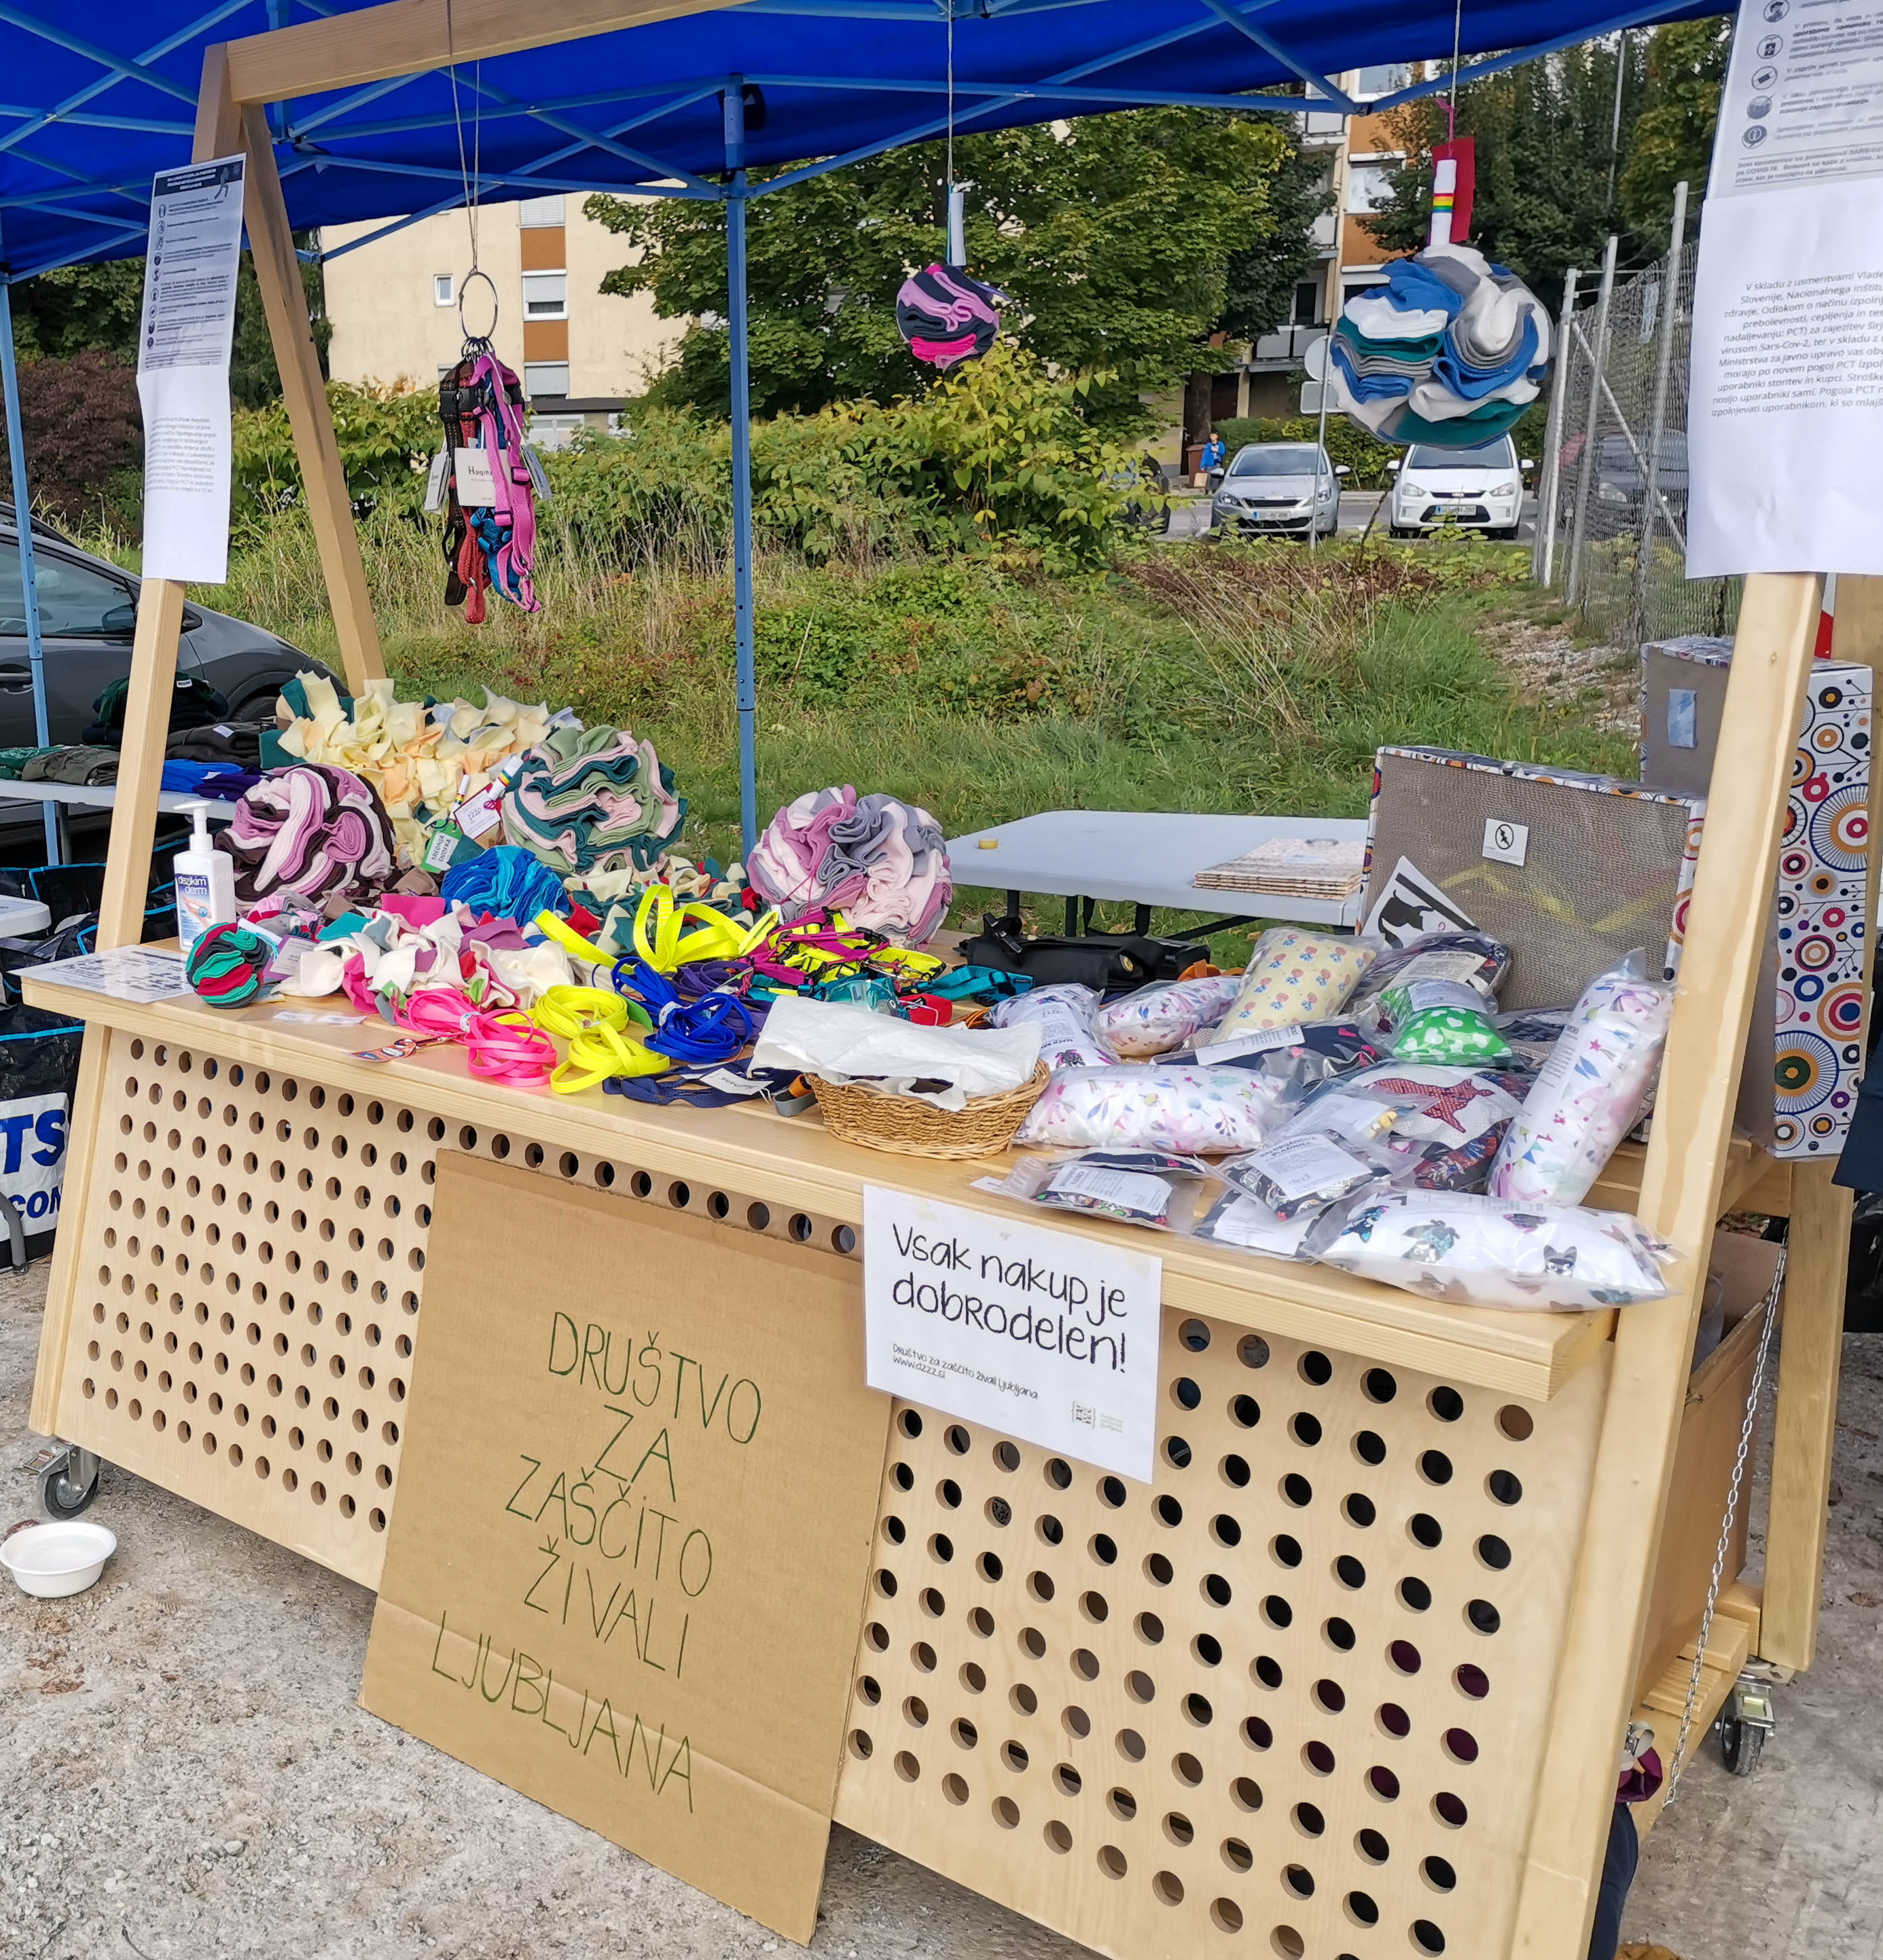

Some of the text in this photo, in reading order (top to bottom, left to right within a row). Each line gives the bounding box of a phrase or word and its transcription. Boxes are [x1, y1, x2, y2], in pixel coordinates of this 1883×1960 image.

[1746, 283, 1753, 291] V
[1754, 280, 1785, 291] skladu
[1794, 272, 1854, 286] usmeritvami
[1857, 270, 1883, 280] Vlade
[1740, 293, 1784, 305] Slovenije,
[1787, 286, 1851, 300] Nacionalnega
[1761, 304, 1804, 315] Odlokom
[1815, 298, 1847, 309] načinu
[1742, 314, 1808, 331] prebolevnosti,
[1810, 310, 1854, 323] cepljenja
[1723, 329, 1785, 343] nadaljevanju:
[1787, 327, 1808, 336] PCT)
[1823, 322, 1865, 333] zajezitev
[1721, 344, 1757, 355] virusom
[1814, 338, 1827, 346] ter
[1836, 334, 1870, 344] skladu
[1719, 356, 1768, 367] Ministrstva
[1770, 355, 1780, 363] za
[1781, 353, 1808, 364] javno
[1810, 350, 1845, 360] upravo
[1723, 359, 1883, 379] morajo po novem pogoj PCT izpol
[1717, 380, 1766, 393] uporabniki
[1768, 377, 1804, 388] storitev
[1804, 376, 1814, 384] in
[1816, 374, 1844, 385] kupci.
[1712, 395, 1738, 405] nosijo
[1740, 390, 1790, 403] uporabniki
[1820, 386, 1853, 397] Pogoja
[1855, 385, 1877, 394] PCT
[1711, 404, 1760, 418] izpolnjevati
[1762, 399, 1827, 414] uporabnikom,
[1830, 398, 1839, 407] ki
[1842, 399, 1853, 407] so
[184, 886, 208, 896] derm
[893, 1222, 1128, 1327] Vsak nakup je
[893, 1355, 946, 1379] www.dzzz.si
[929, 1356, 941, 1366] za
[942, 1360, 975, 1378] zaščito
[548, 1311, 761, 1445] DRUŠTVO
[594, 1404, 676, 1503] ZA
[524, 1534, 689, 1680] ŽIVALI
[431, 1610, 694, 1814] LJUBLJANA
